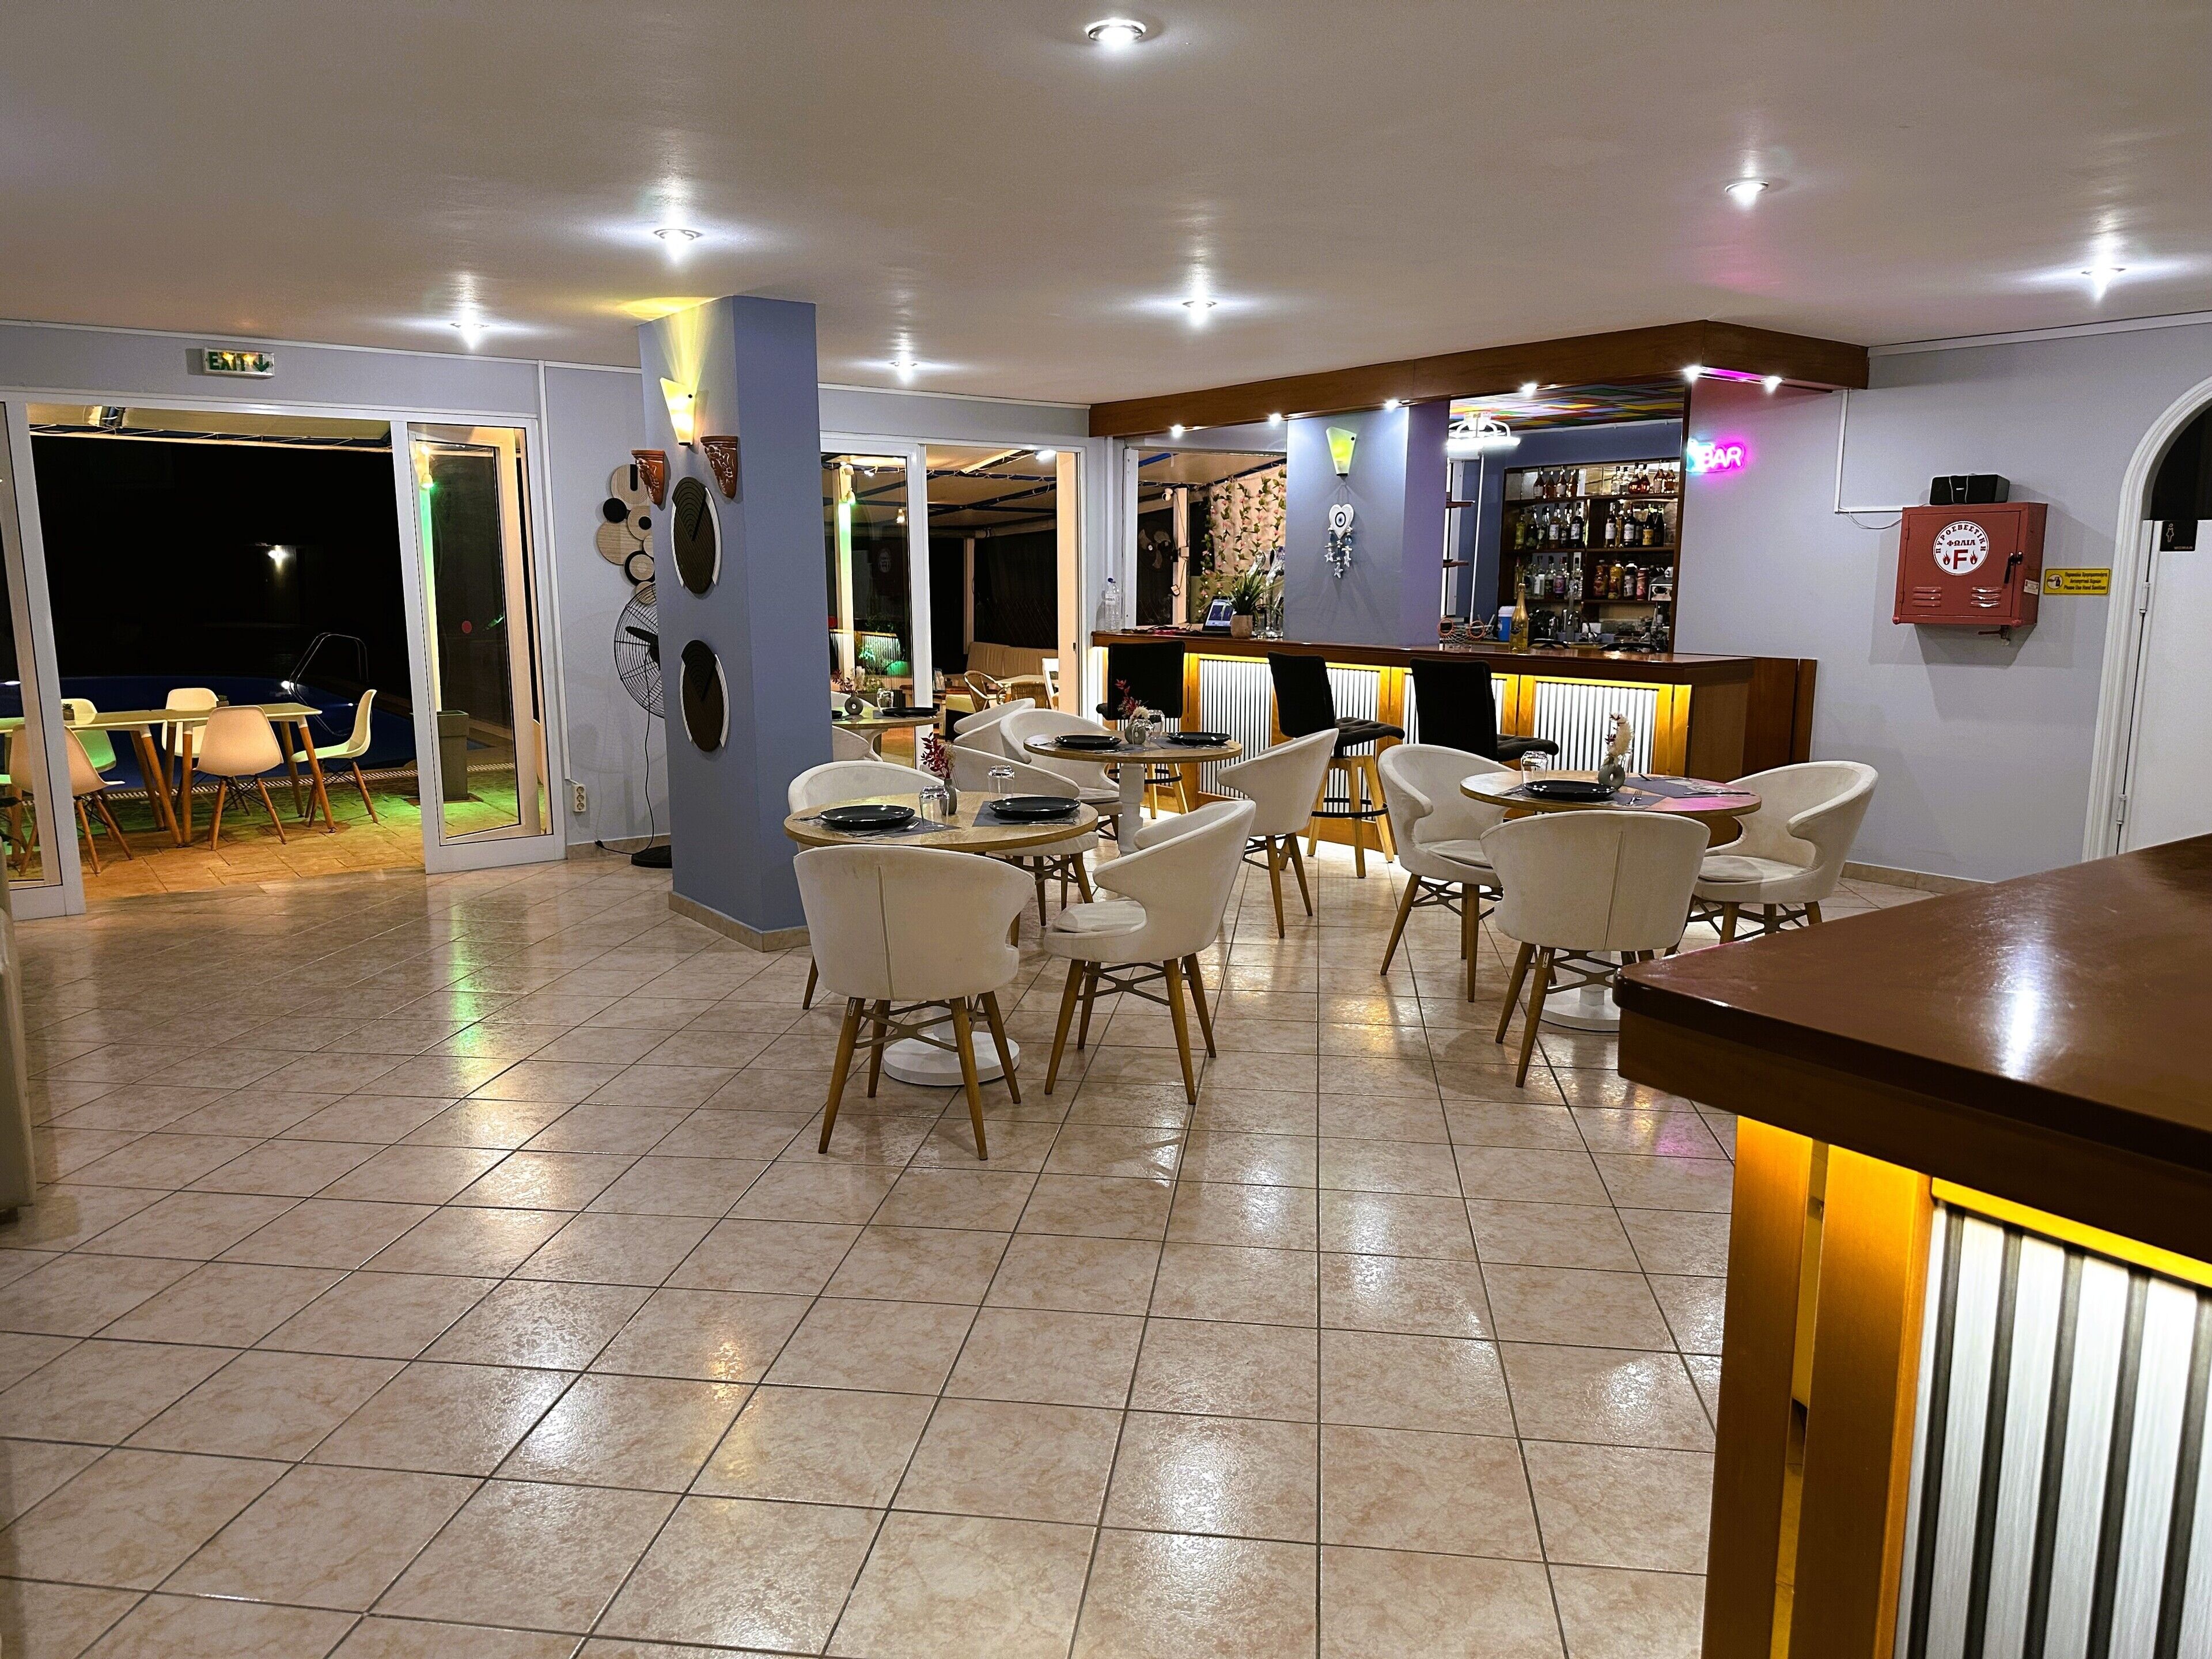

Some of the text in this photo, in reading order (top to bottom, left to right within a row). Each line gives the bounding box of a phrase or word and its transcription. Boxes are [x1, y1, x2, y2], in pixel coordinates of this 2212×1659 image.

[209, 351, 251, 371] EXIT
[1700, 445, 1743, 469] BAR
[1936, 524, 1986, 554] ΠΥΡΟΣΒΕΣΤΙΚΗ
[1953, 549, 1968, 570] F
